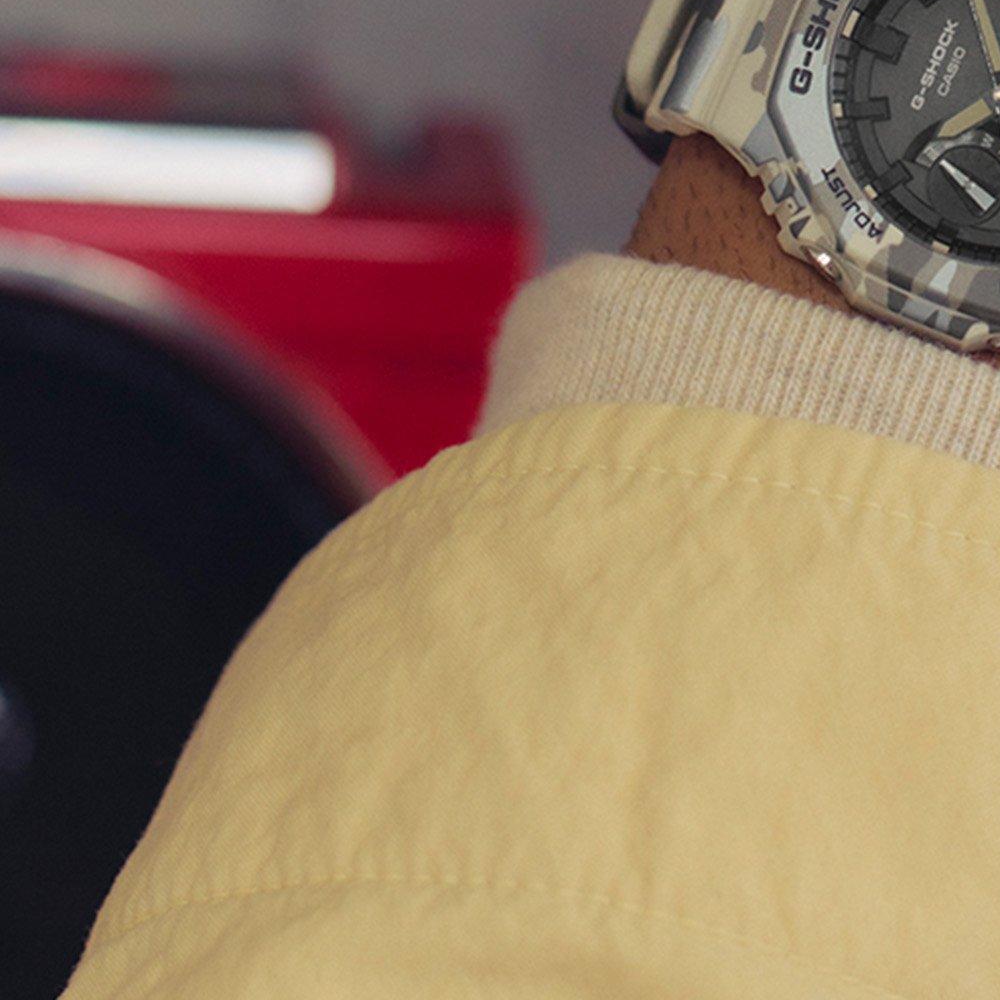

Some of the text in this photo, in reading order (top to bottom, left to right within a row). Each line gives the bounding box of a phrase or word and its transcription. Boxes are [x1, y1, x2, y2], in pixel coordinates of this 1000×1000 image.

[910, 18, 960, 111] G-SHOCK
[936, 45, 967, 98] CASIO
[820, 166, 883, 244] ADJUST
